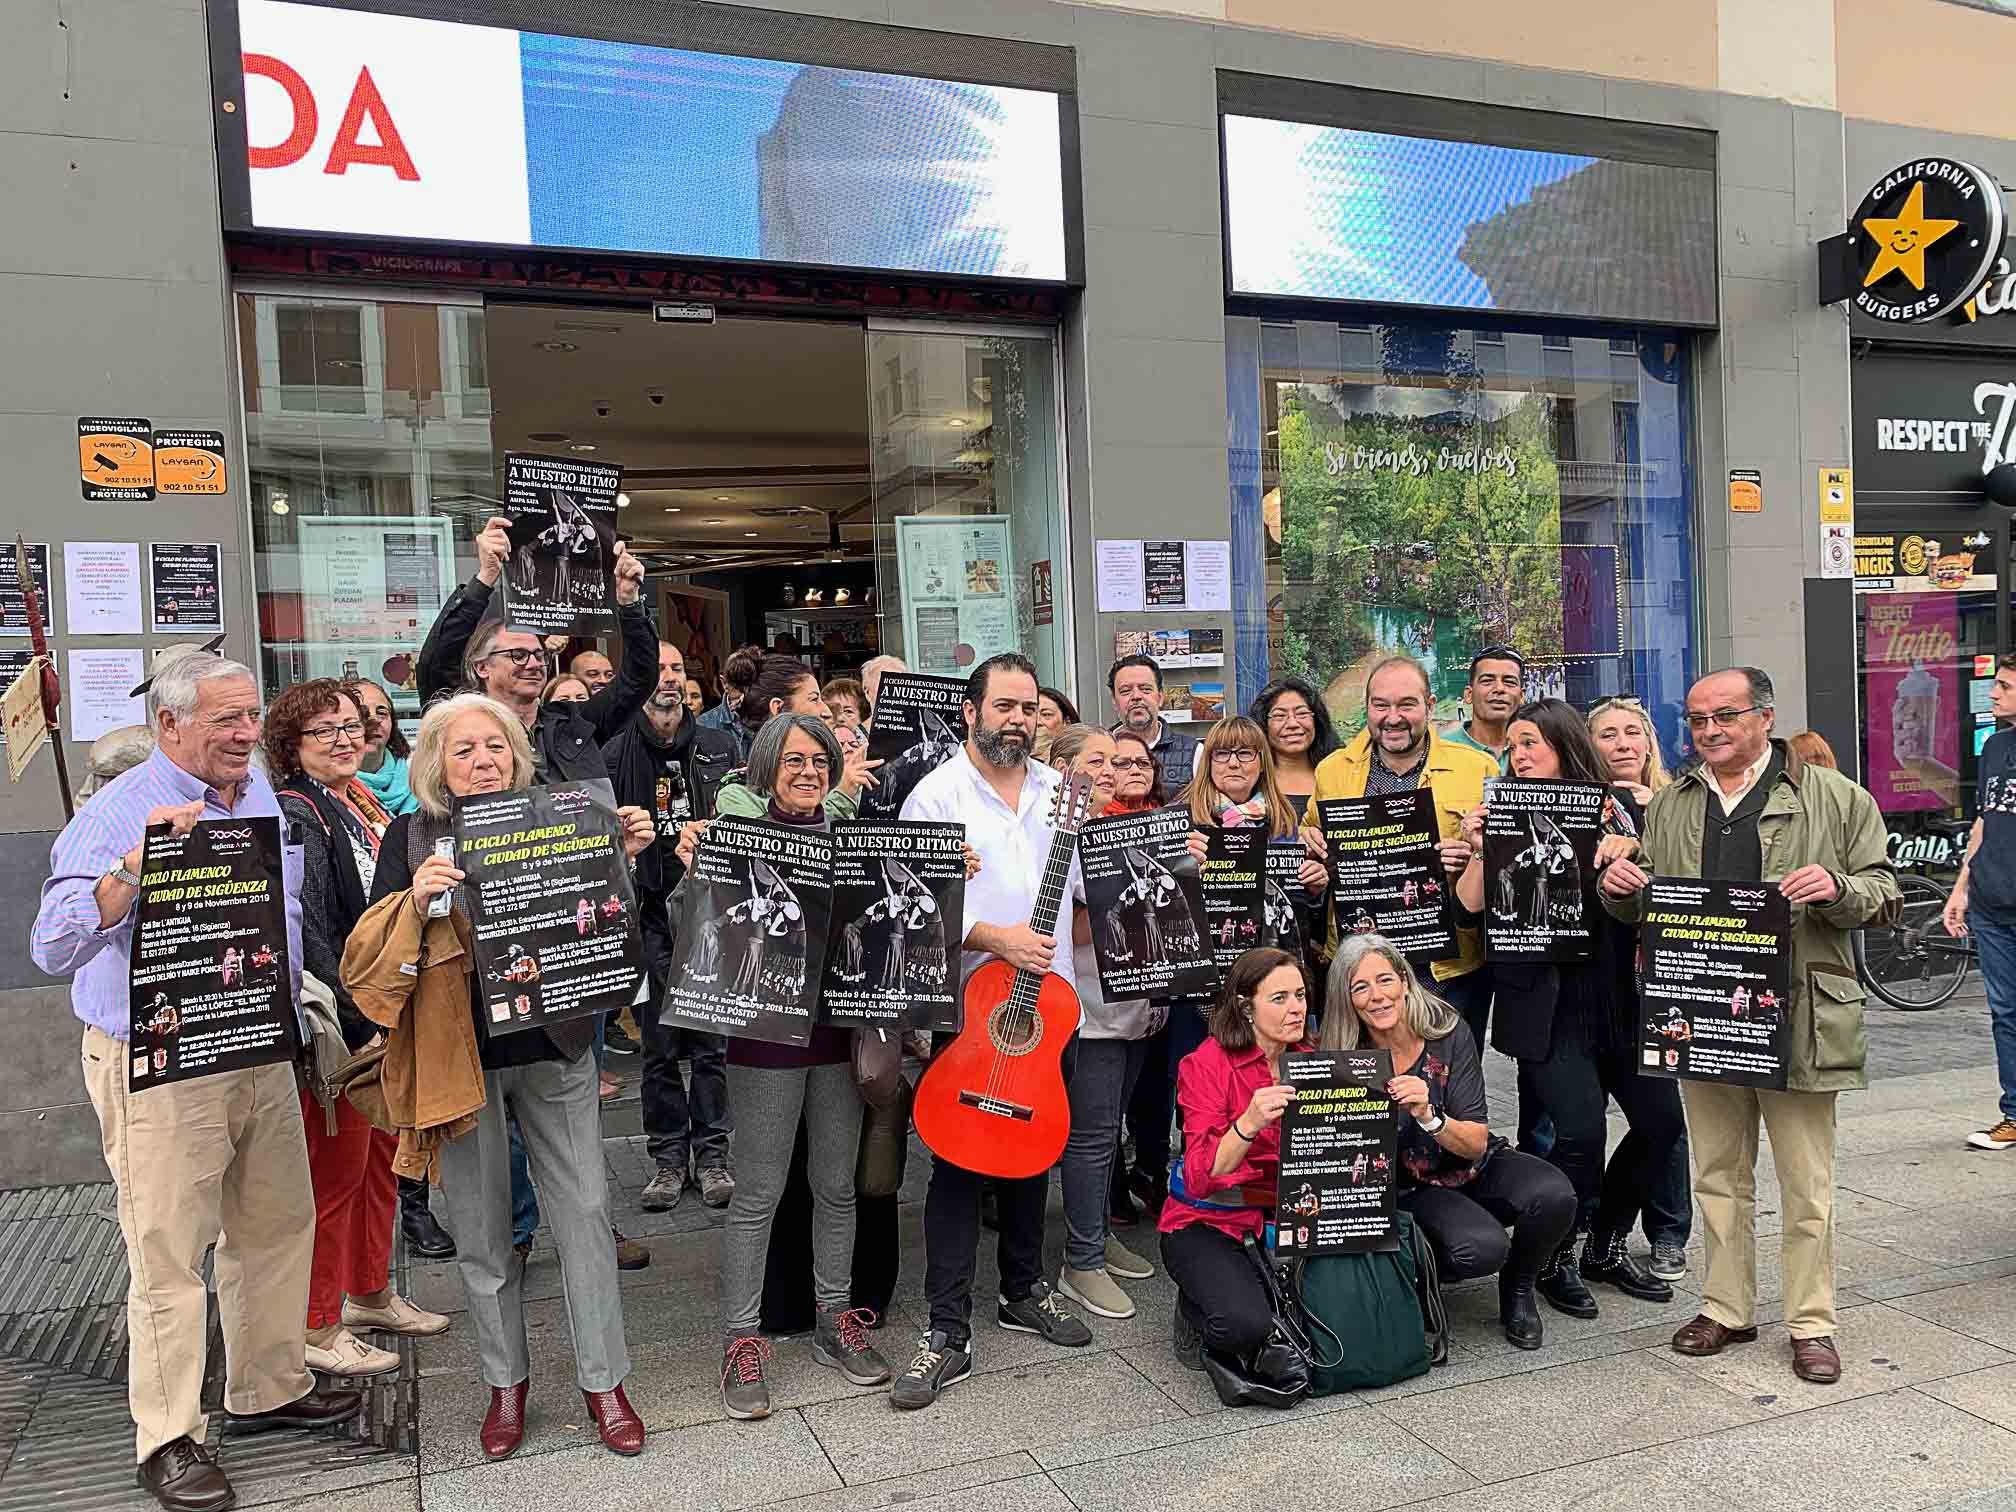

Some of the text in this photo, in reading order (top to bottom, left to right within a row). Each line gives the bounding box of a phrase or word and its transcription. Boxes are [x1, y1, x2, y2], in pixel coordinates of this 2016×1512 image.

[1872, 161, 1976, 200] CALIFORNIA
[1856, 291, 1940, 320] BURGERS
[80, 425, 149, 433] VIDEOVIGILADA
[1877, 418, 1992, 452] RESPECT THE
[156, 438, 222, 447] PROTEGIDA
[516, 458, 533, 466] CICLO
[534, 460, 562, 469] FLAMENCO
[593, 467, 618, 476] SIGÜENZA
[522, 468, 576, 483] NUESTRO
[580, 474, 617, 489] RITMO
[934, 682, 955, 690] CIUDAD
[893, 687, 947, 702] NUESTRO
[1501, 791, 1556, 804] NUESTRO
[1559, 793, 1600, 806] RITMO
[1084, 824, 1100, 832] CICLO
[1101, 820, 1130, 830] FLAMENCO
[1131, 816, 1151, 825] CIUDAD
[1093, 825, 1145, 844] NUESTRO
[1149, 819, 1189, 835] RITMO
[1334, 829, 1357, 838] CICLO
[1358, 824, 1404, 837] FLAMENCO
[474, 833, 511, 850] CICLO
[513, 823, 576, 844] FLAMENCO
[730, 822, 764, 834] FLAMENCO
[766, 828, 790, 839] CIUDAD
[801, 834, 832, 847] SIGÜENZA
[896, 827, 920, 835] CIUDAD
[932, 828, 963, 838] SIGÜENZA
[715, 830, 781, 852] NUESTRO
[786, 841, 831, 861] RITMO
[848, 836, 912, 849] NUESTRO
[916, 838, 961, 851] RITMO
[1339, 839, 1370, 851] CIUDAD
[1385, 832, 1429, 847] SIGÜENZA
[483, 834, 609, 865] CIUDAD DE SIGÜENZA
[554, 852, 593, 865] Noviembre
[595, 847, 613, 858] 2019
[748, 849, 766, 858] baile
[778, 855, 800, 865] ISABEL
[1280, 857, 1304, 868] RITMO
[148, 870, 169, 884] CICLO
[170, 866, 231, 882] FLAMENCO
[1217, 871, 1257, 881] SIGÜENZA
[148, 879, 268, 903] CIUDAD DE SIGÜENZA
[480, 880, 494, 890] Café
[205, 894, 269, 908] Noviembre 2019
[482, 890, 500, 898] Paseo
[483, 898, 507, 907] Reserva
[1657, 913, 1688, 924] CICLO
[1689, 916, 1747, 929] FLAMENCO
[1662, 928, 1777, 946] CIUDAD DE SIGÜENZA
[1721, 943, 1778, 955] Noviembre 2019
[824, 990, 852, 998] Sábado
[828, 1000, 866, 1008] Auditorio
[879, 1000, 907, 1010] PÓSITO
[831, 1009, 898, 1018] Entrada Gratuita
[1296, 1087, 1368, 1101] CICLO FLAMENCO
[1299, 1104, 1333, 1115] CIUDAD
[1347, 1100, 1389, 1112] SIGÜENZA
